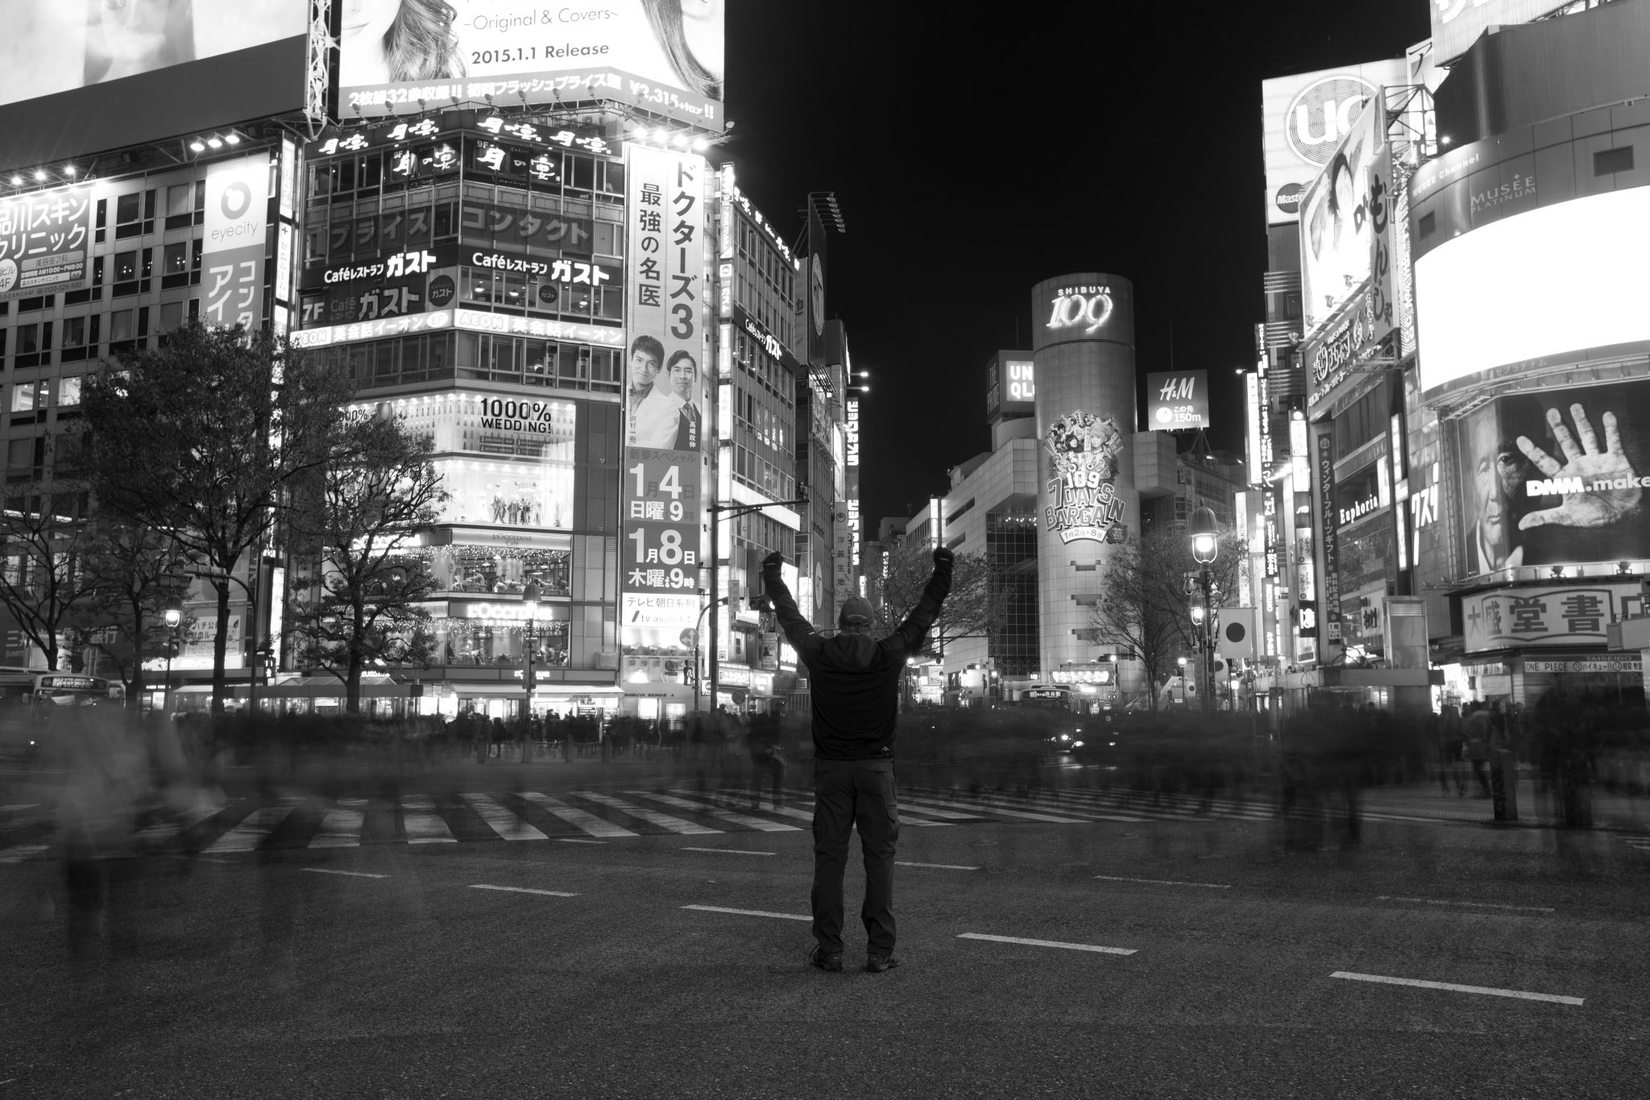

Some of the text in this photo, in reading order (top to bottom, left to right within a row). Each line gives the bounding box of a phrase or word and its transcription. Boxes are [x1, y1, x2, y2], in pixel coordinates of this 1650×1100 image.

[540, 9, 553, 25] &
[472, 42, 610, 65] 2015.1.1 Release
[211, 222, 258, 242] eyecity
[462, 205, 590, 245] コンタクト
[638, 182, 663, 308] 最強の名医
[669, 161, 698, 340] ドクターズ3
[386, 249, 437, 278] ガスト
[551, 259, 610, 286] ガスト
[358, 286, 420, 321] ガスト
[1057, 286, 1111, 296] SHIBUYA
[302, 301, 325, 321] 7F
[1046, 294, 1114, 334] 109
[1010, 365, 1033, 381] UN
[1010, 382, 1035, 399] QL
[1160, 377, 1195, 400] H&M
[480, 398, 552, 422] 1000%
[1174, 412, 1202, 423] 150m
[629, 462, 695, 500] 1月4日
[1046, 476, 1115, 509] 7 DAYS
[1066, 471, 1100, 489] 109
[1044, 496, 1127, 531] BARGAIN
[1339, 493, 1379, 525] Euphoria
[628, 527, 695, 565] 1月8日
[1544, 662, 1568, 672] PIECE
